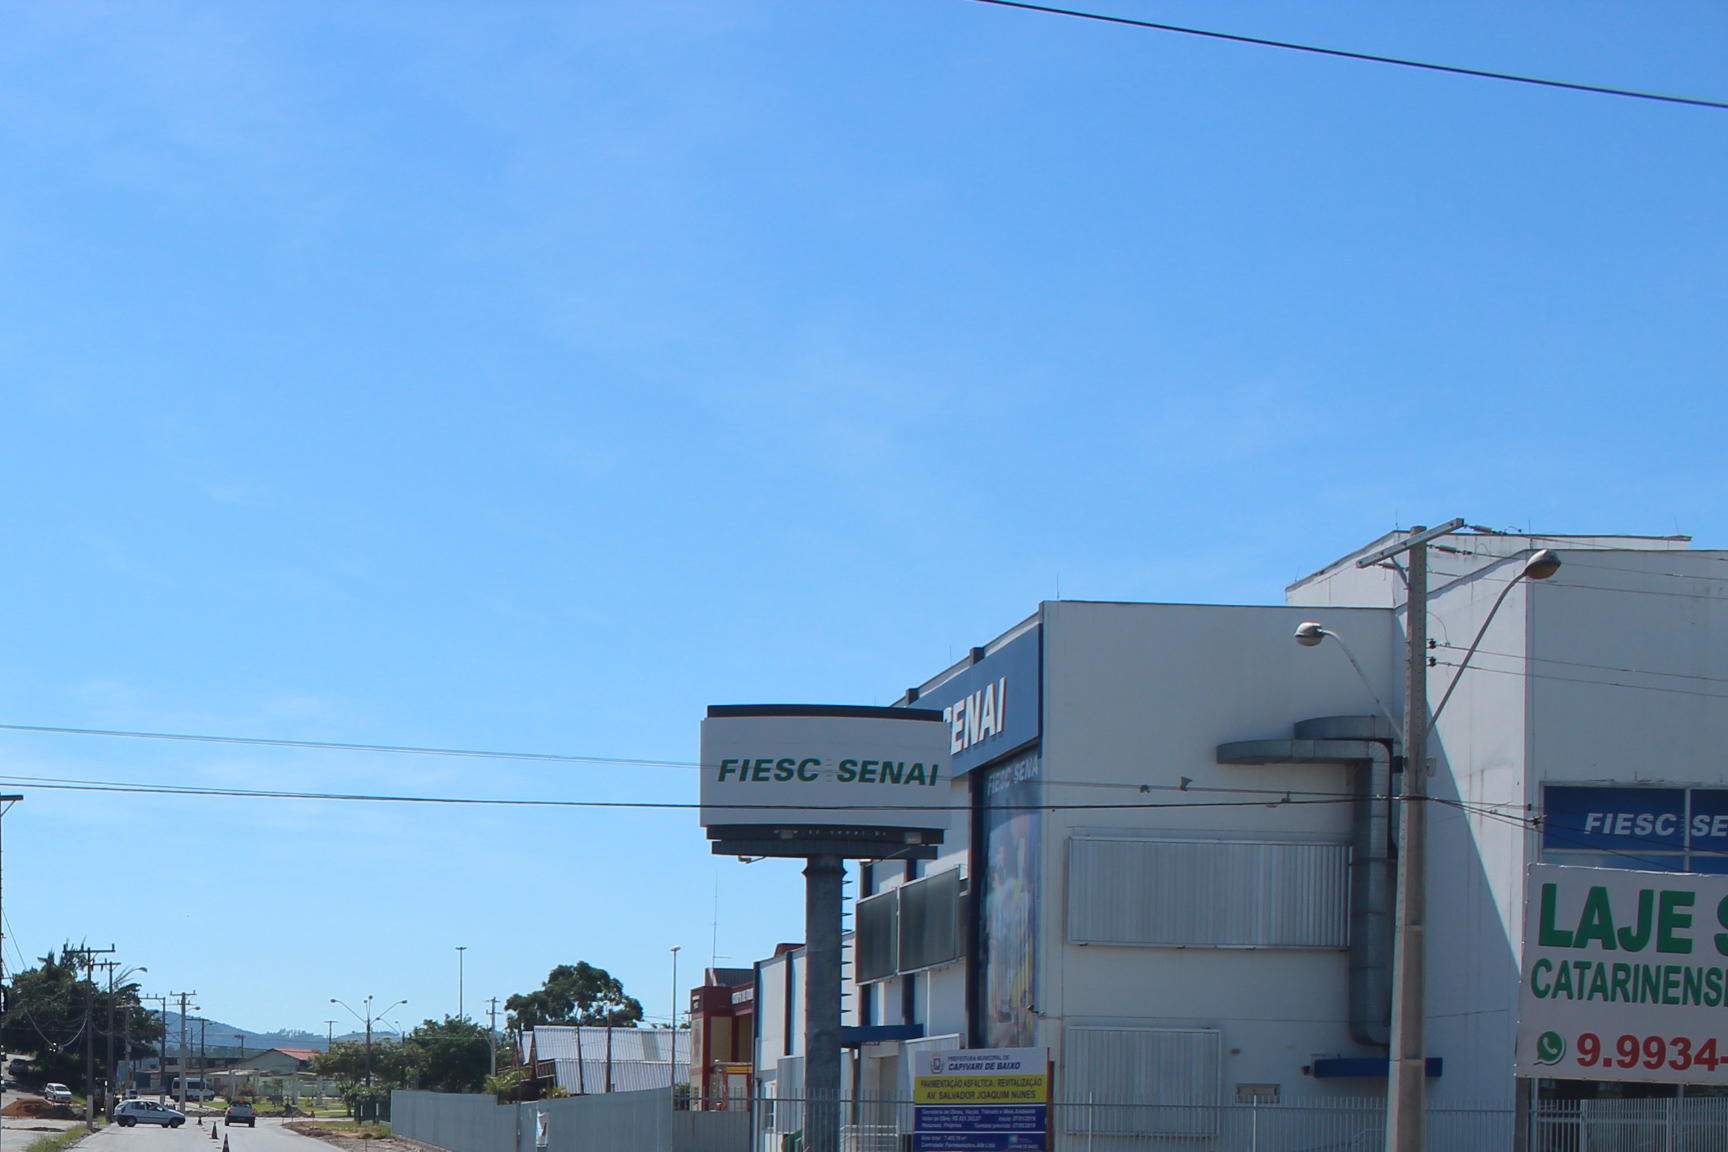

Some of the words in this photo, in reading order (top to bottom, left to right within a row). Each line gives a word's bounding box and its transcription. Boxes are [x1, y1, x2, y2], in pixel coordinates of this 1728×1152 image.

[718, 758, 821, 782] FIESC
[836, 759, 940, 786] SENAI
[987, 767, 1011, 797] FIESC
[1584, 813, 1677, 835] FIESC
[1538, 883, 1696, 954] LAJE
[1531, 957, 1728, 1008] CATARINENS
[948, 1062, 983, 1071] CAPIVARI
[984, 1062, 996, 1070] DE
[997, 1061, 1021, 1070] BAIXO
[921, 1078, 962, 1089] PAVIMENTAÇÃO
[964, 1078, 993, 1088] ASFÁLTICA
[998, 1077, 1042, 1088] REVITALIZAÇÃO
[926, 1091, 937, 1099] AV.
[939, 1091, 976, 1100] SALVADOR
[978, 1090, 1010, 1100] JOAQUIM
[1012, 1090, 1036, 1099] NUNES
